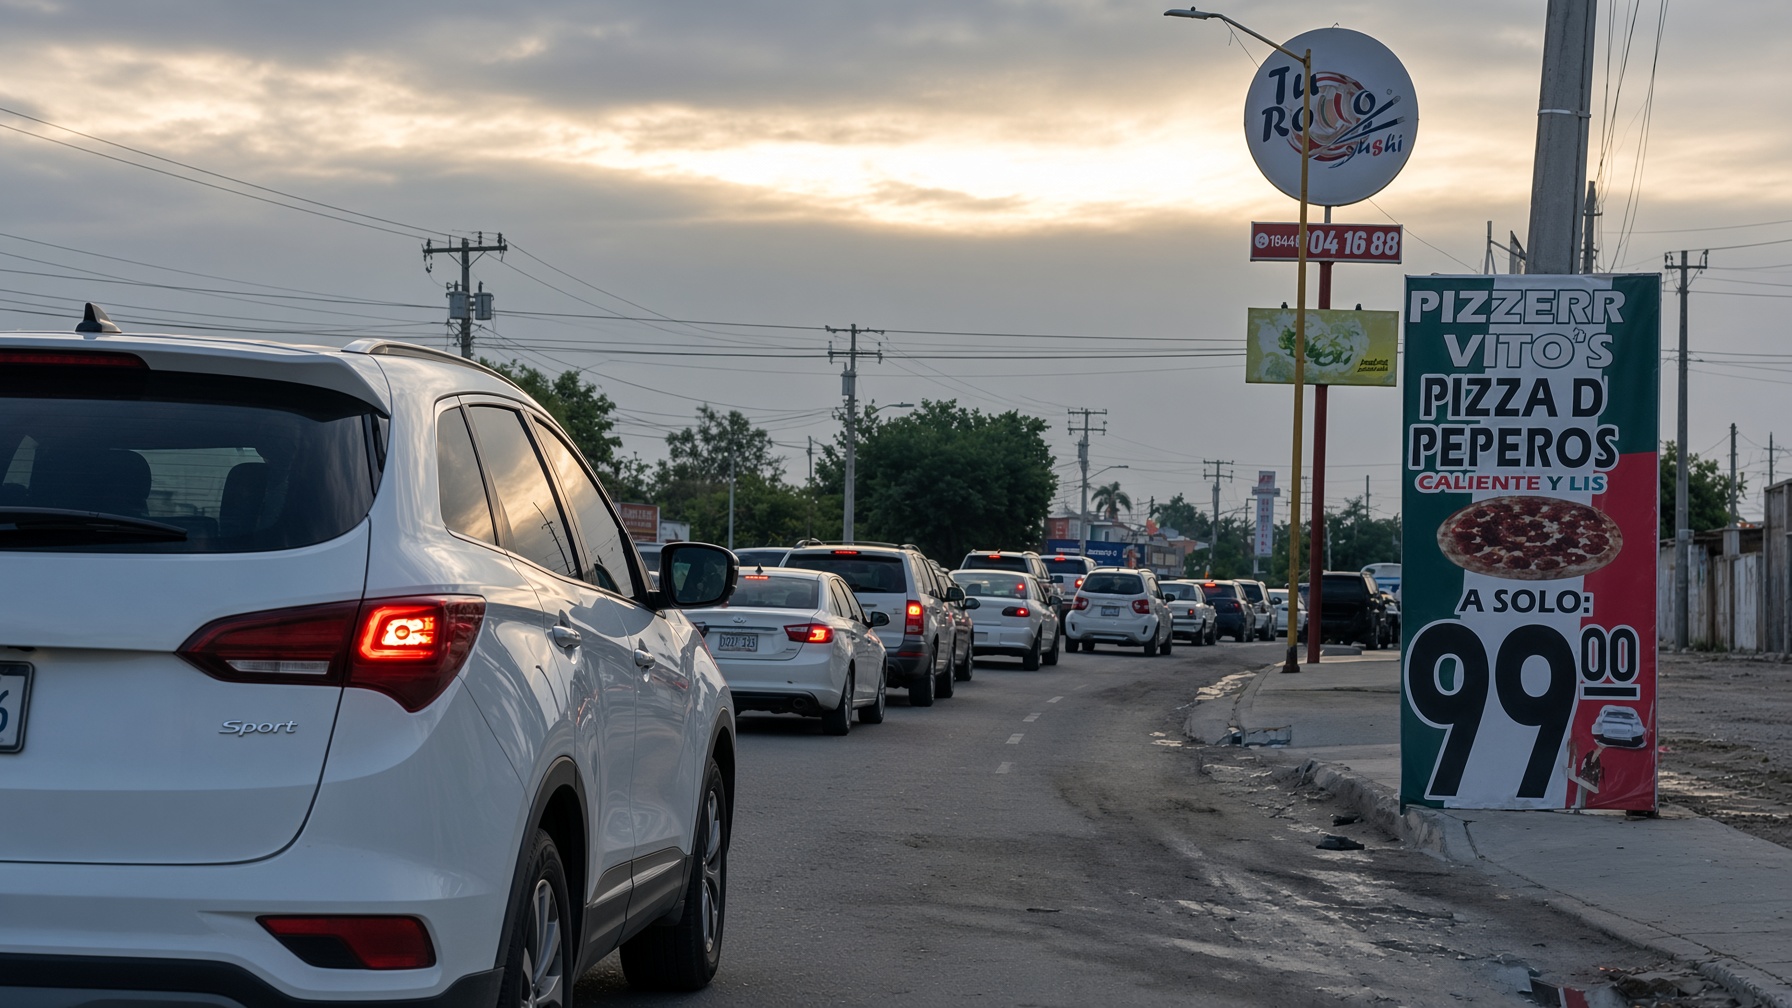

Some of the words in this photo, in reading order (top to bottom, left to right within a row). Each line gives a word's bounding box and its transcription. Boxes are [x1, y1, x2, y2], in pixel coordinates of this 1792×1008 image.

[1269, 66, 1319, 105] Tu
[1344, 230, 1367, 255] 16
[1370, 231, 1399, 256] 88
[1409, 289, 1626, 324] PIZZERR
[1422, 376, 1559, 418] PIZZA
[1571, 376, 1605, 418] D
[1411, 426, 1617, 469] PEPEROS
[1418, 475, 1541, 491] CALIENTE
[1547, 475, 1564, 491] Y
[1569, 475, 1605, 491] LIS
[1459, 589, 1485, 613] A
[1493, 589, 1590, 614] SOLO:
[1408, 622, 1577, 799] 99
[219, 720, 299, 737] Sport
